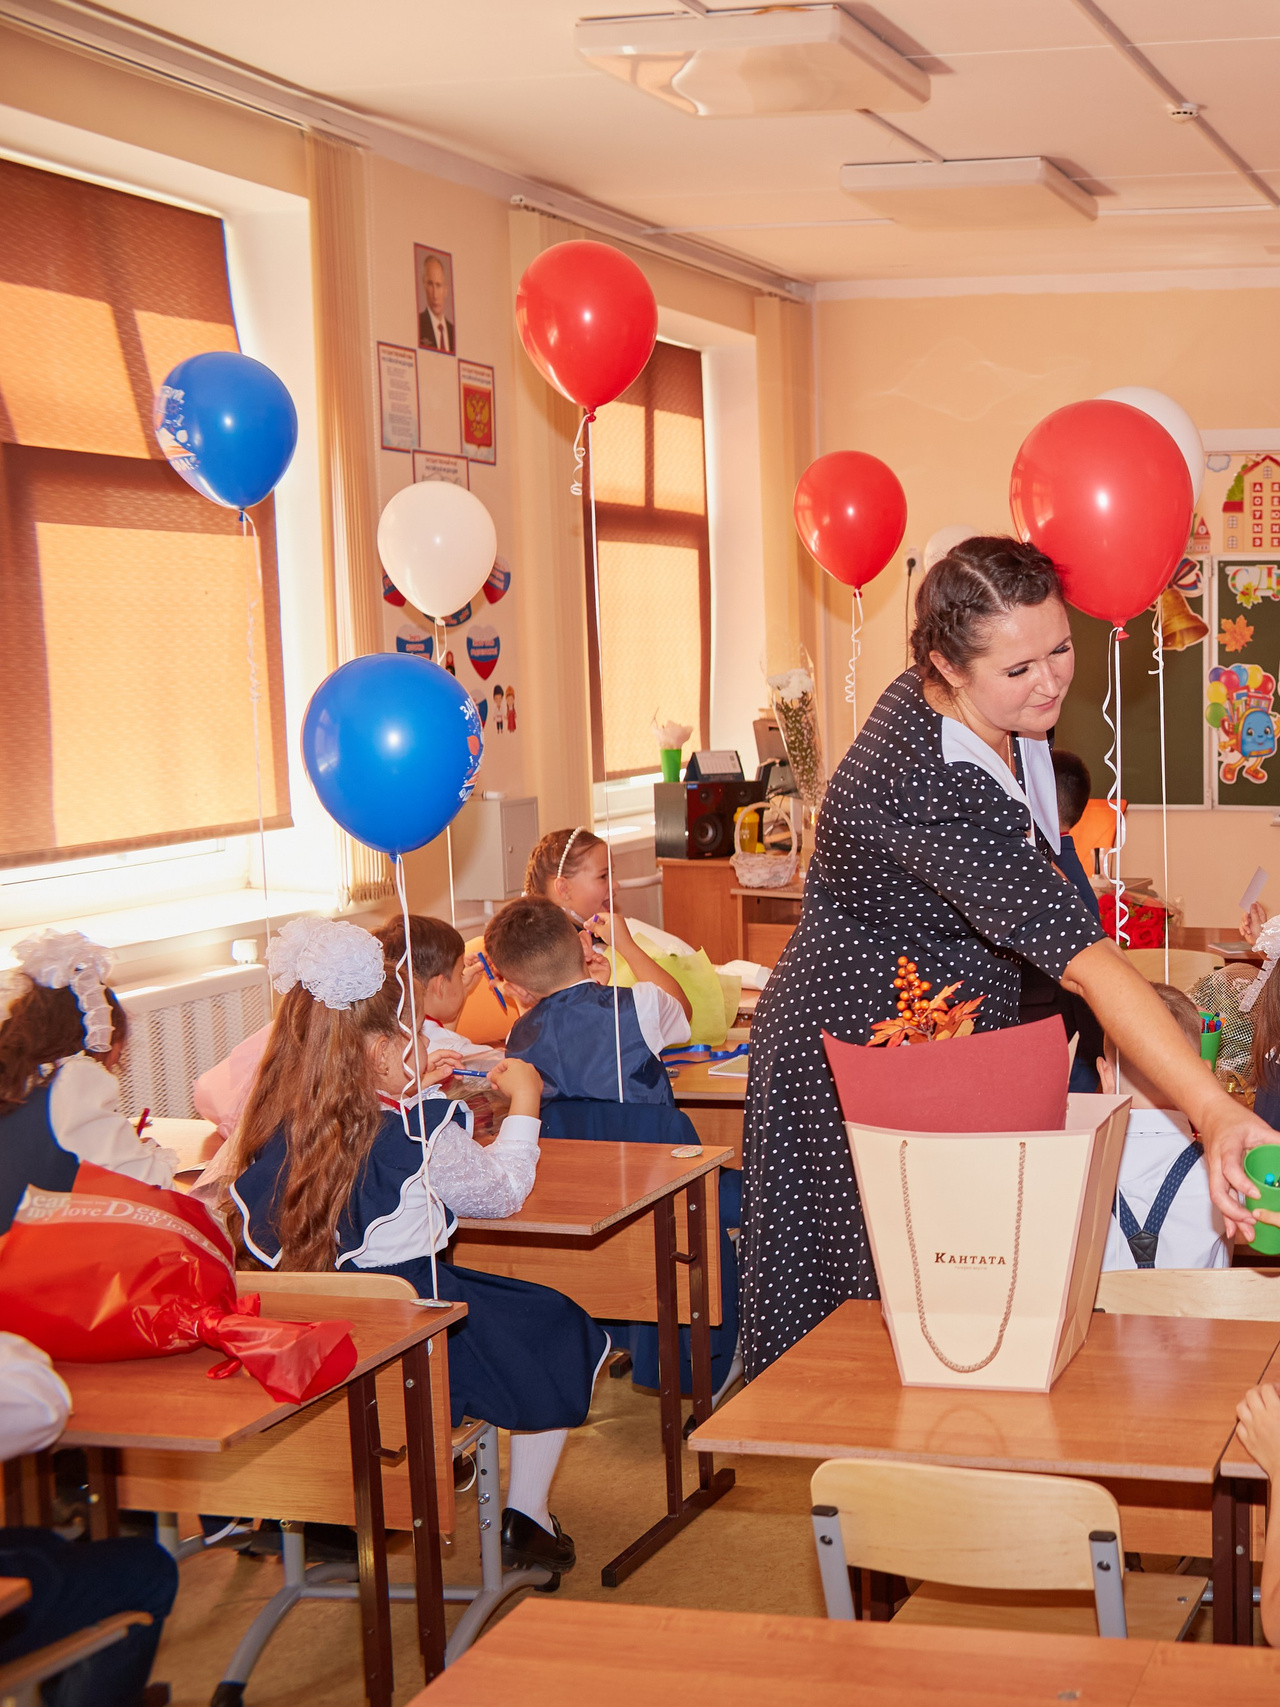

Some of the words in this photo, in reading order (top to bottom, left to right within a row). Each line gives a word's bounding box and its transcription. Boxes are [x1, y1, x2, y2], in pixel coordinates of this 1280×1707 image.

[61, 1204, 103, 1217] love
[131, 1213, 161, 1226] my
[165, 1220, 200, 1240] love
